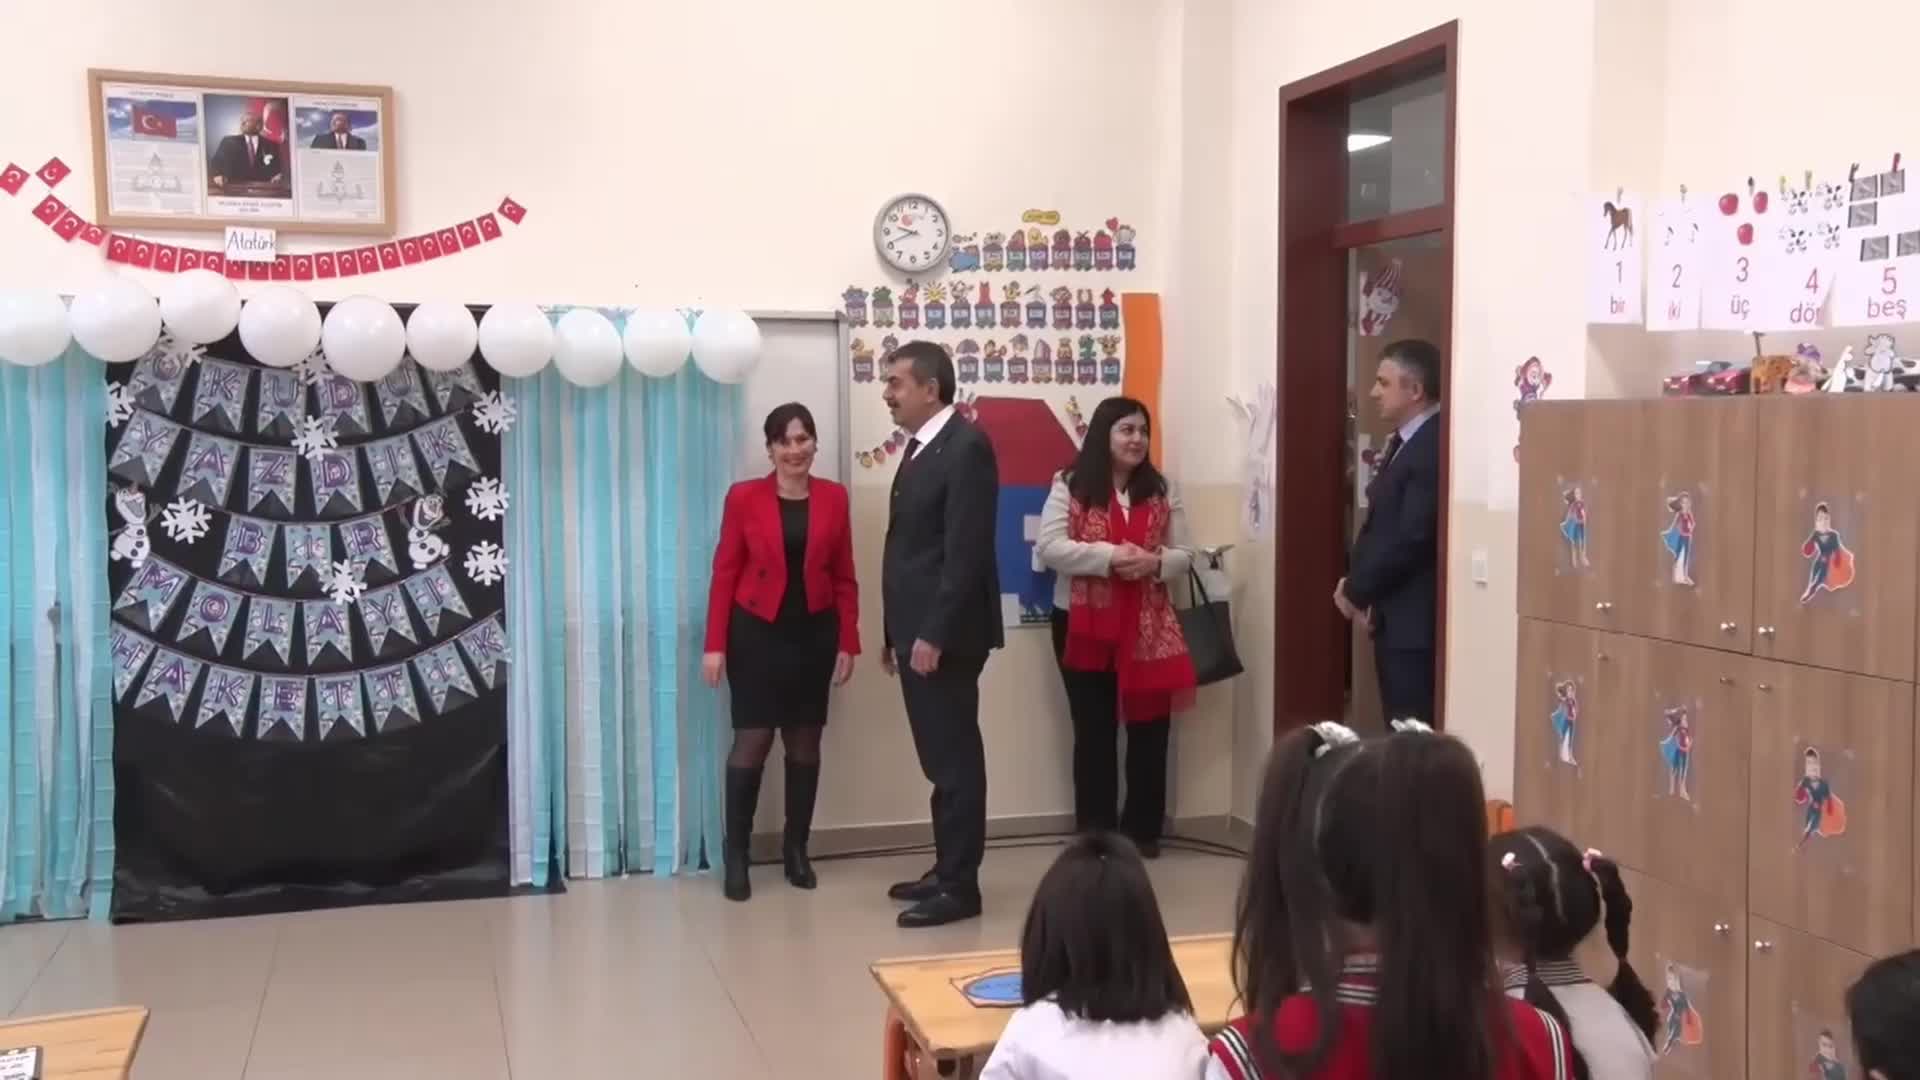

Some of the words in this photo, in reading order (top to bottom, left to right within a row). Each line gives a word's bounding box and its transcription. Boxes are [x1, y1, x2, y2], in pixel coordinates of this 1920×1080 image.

[1615, 260, 1623, 284] 1
[1671, 264, 1682, 288] 2
[1736, 256, 1749, 282] 3
[1805, 267, 1819, 294] 4
[1881, 266, 1897, 295] 5
[1610, 295, 1626, 314] bir
[1730, 294, 1751, 320] üç
[1789, 301, 1825, 323] dör
[1866, 296, 1908, 320] beş
[152, 349, 464, 410] OKUDU
[136, 418, 458, 489] YAZDIK
